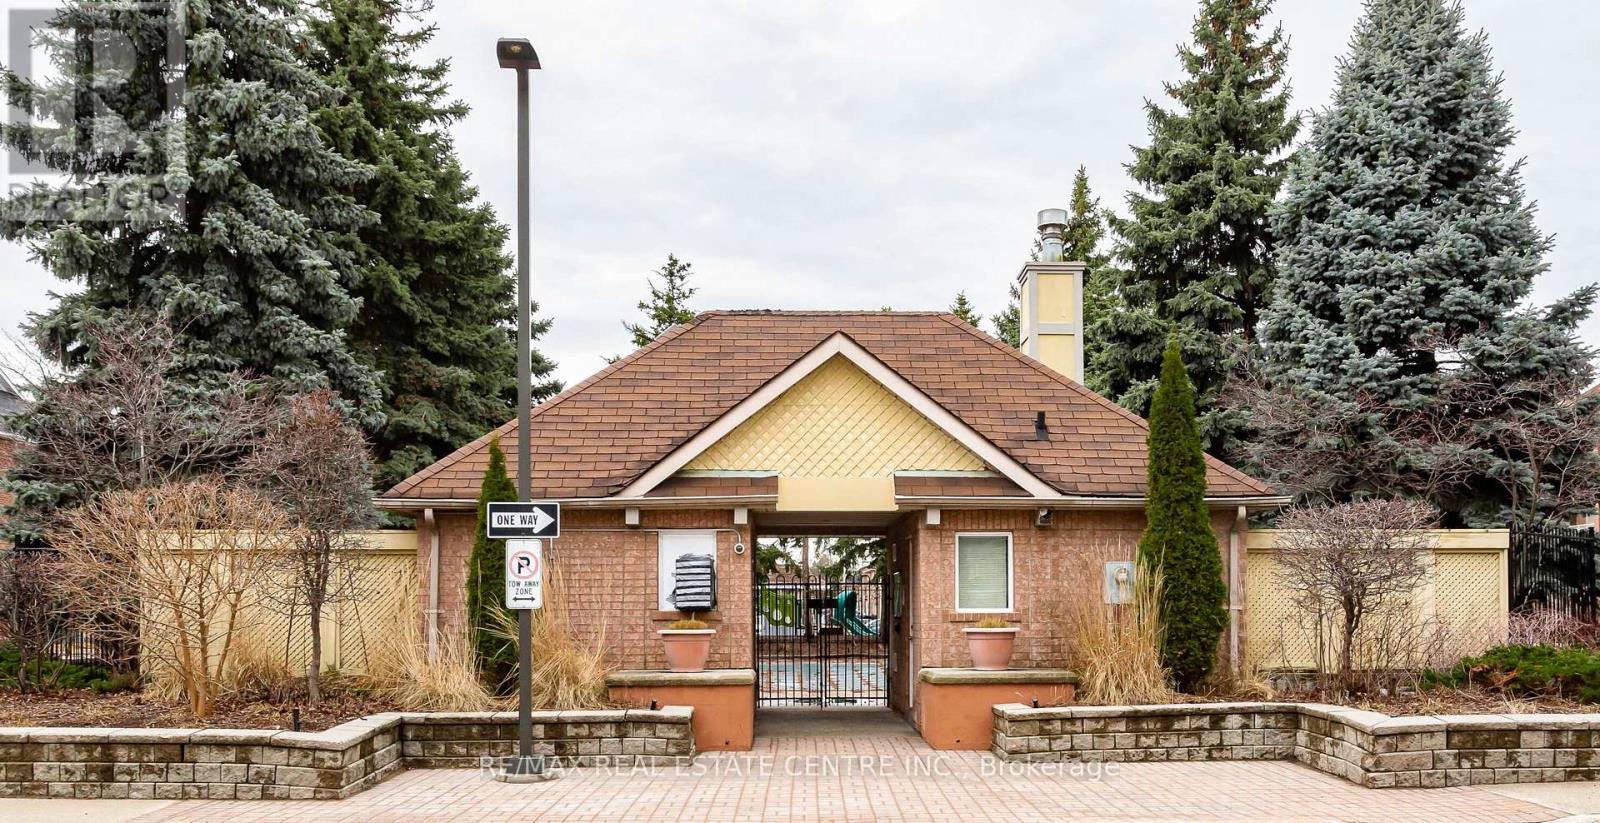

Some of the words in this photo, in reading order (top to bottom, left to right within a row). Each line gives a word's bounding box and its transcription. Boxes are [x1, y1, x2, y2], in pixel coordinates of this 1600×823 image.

[497, 514, 515, 525] ONE
[519, 514, 539, 525] WAY
[508, 580, 522, 588] TOW
[523, 580, 540, 588] AWAY
